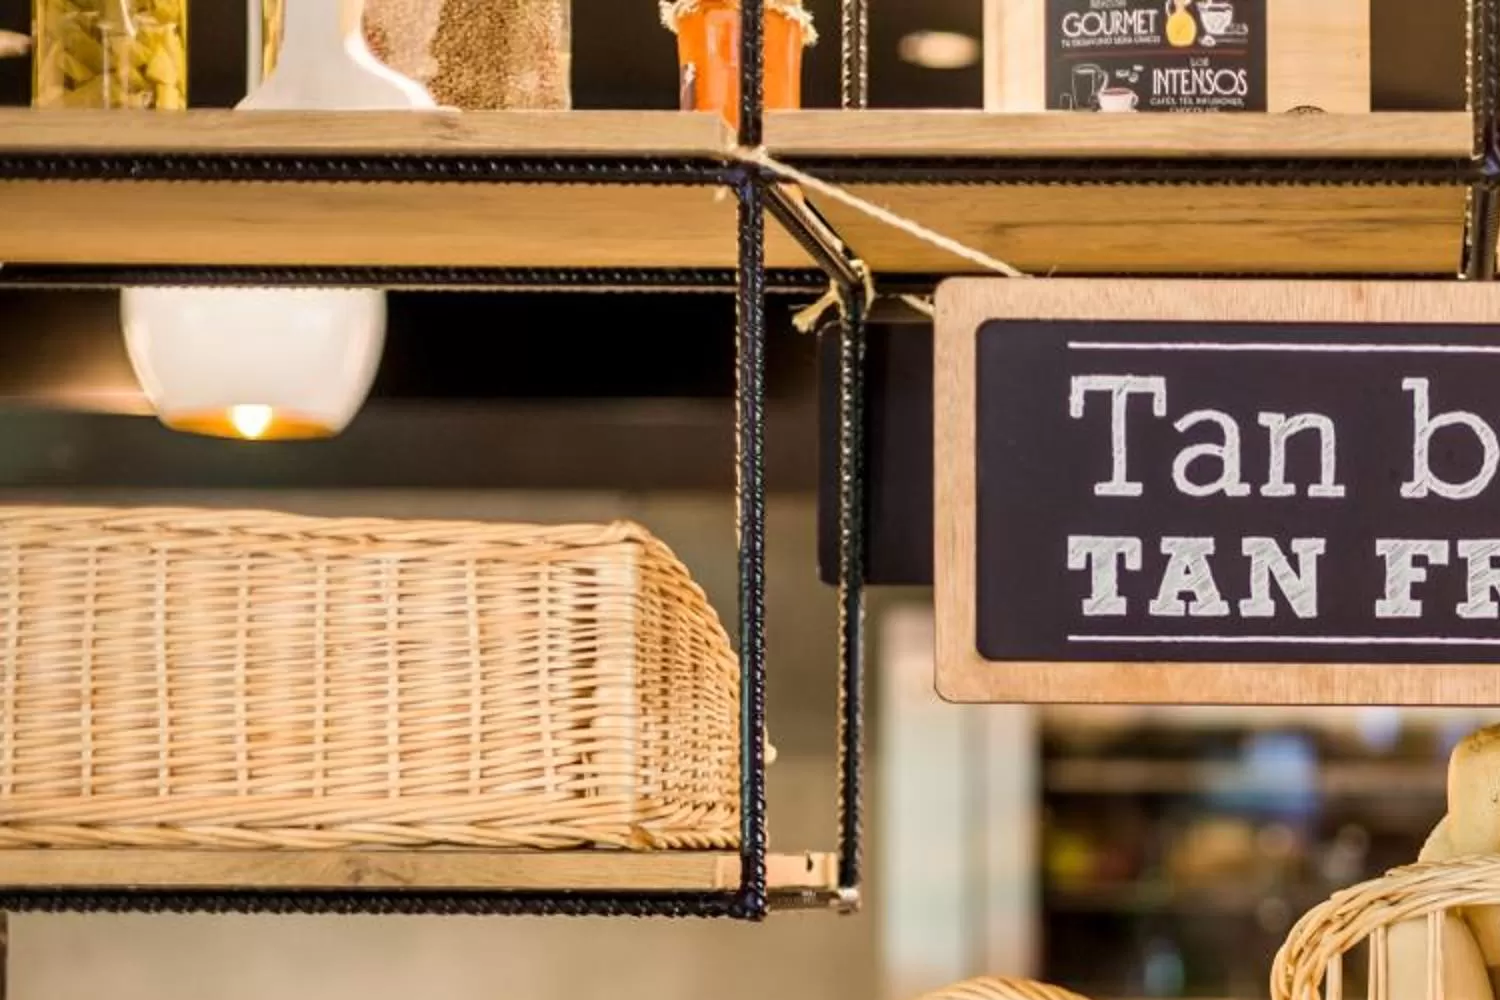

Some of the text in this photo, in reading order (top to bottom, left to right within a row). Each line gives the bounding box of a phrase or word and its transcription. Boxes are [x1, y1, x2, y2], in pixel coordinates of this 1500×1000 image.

[1062, 9, 1158, 37] GOURMET
[1152, 67, 1248, 96] INTENSOS
[1067, 374, 1346, 498] Tan
[1066, 535, 1326, 618] TAN
